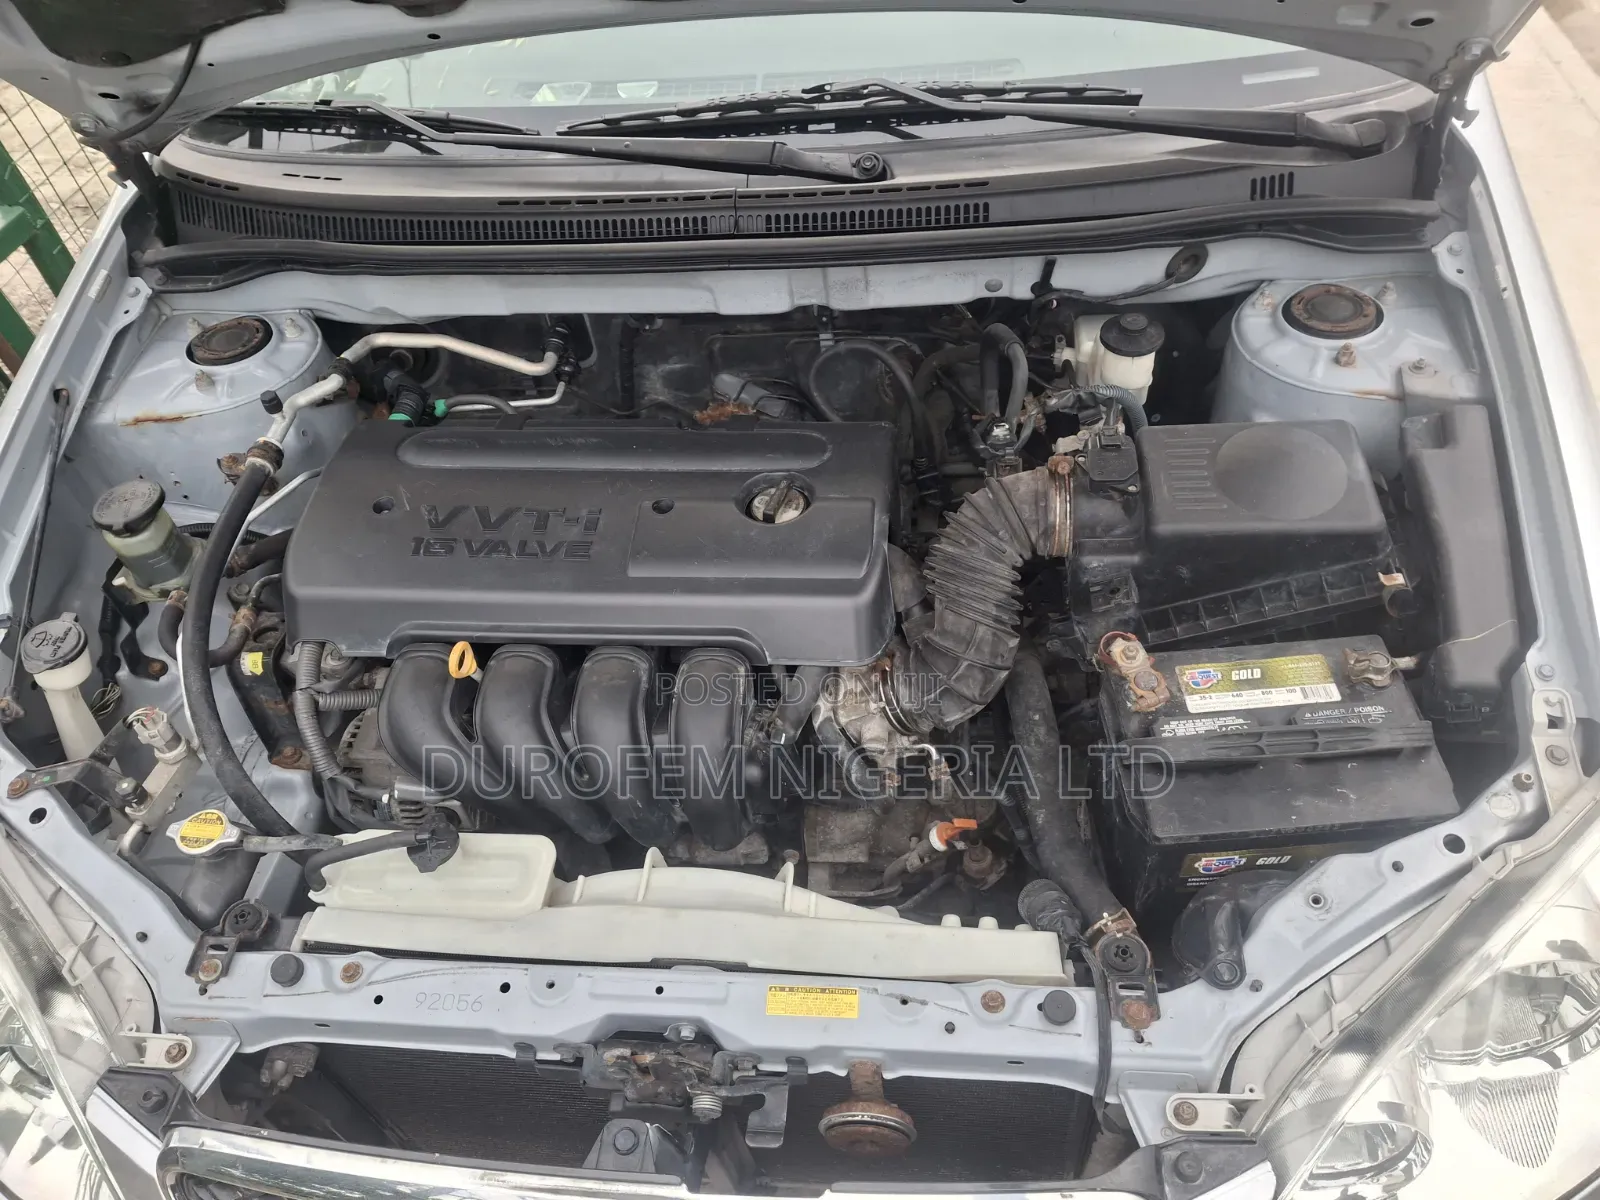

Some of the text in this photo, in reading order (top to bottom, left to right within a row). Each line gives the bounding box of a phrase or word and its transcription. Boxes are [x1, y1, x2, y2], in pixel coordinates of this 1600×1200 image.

[411, 536, 593, 561] 16 VALVE
[1231, 668, 1262, 681] GOLD
[1353, 705, 1385, 714] POISON
[1256, 856, 1292, 865] GOLD
[415, 991, 484, 1013] 92056
